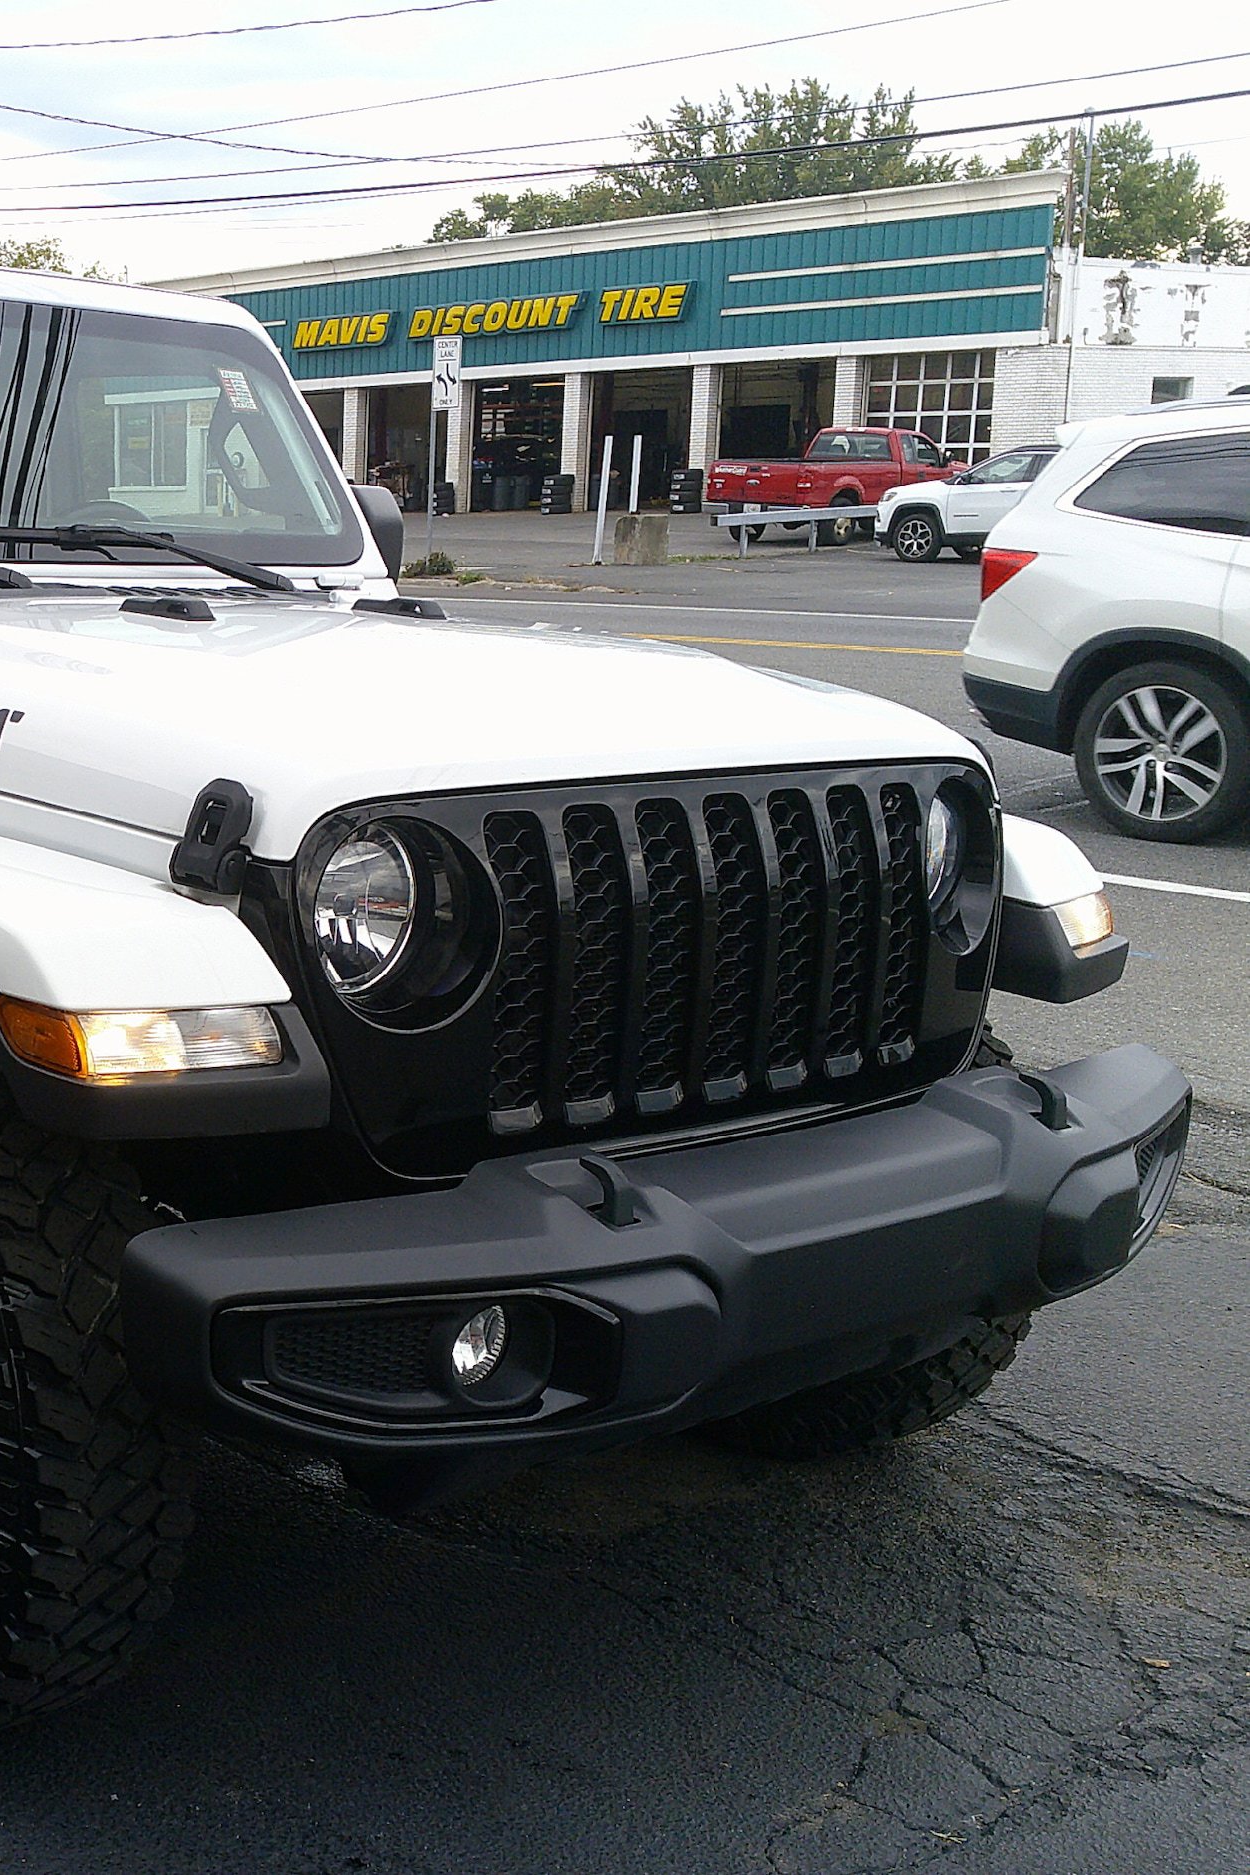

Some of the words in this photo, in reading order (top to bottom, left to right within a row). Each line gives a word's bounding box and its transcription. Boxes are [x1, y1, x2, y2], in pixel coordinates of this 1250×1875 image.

[292, 313, 390, 349] MAVIS
[408, 294, 579, 339] DISCOUNT
[599, 283, 688, 323] TIRE
[438, 341, 458, 349] CENTER
[440, 350, 455, 358] LANE
